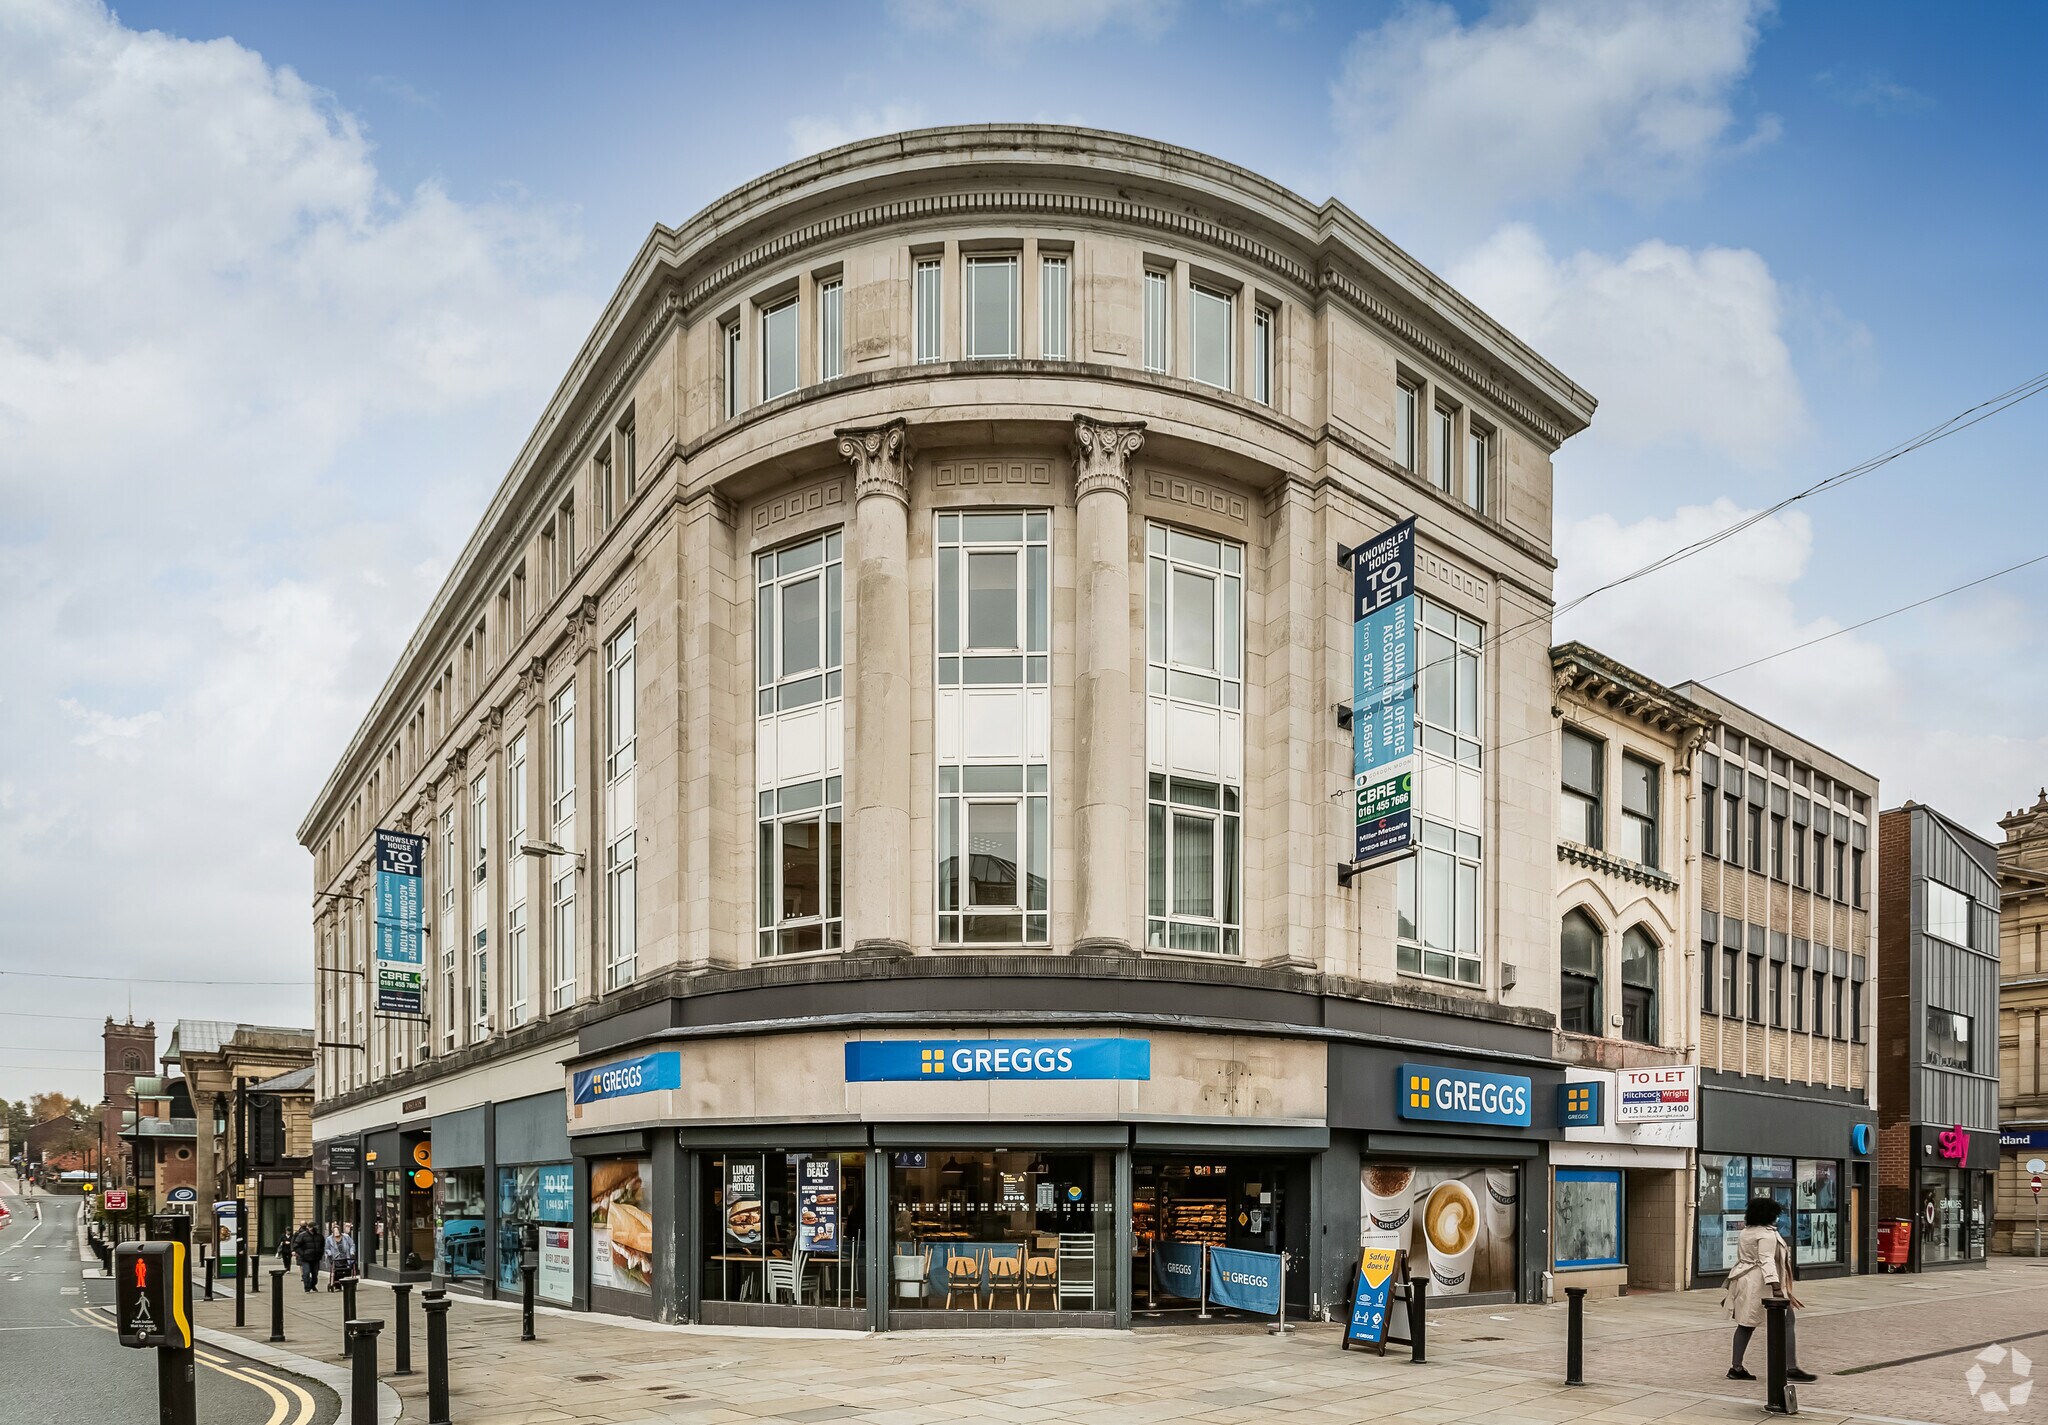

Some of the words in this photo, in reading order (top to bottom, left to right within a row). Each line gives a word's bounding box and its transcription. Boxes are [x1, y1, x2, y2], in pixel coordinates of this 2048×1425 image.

[1359, 527, 1411, 565] KNOWSLEY
[1368, 547, 1400, 571] HOUSE
[1366, 561, 1402, 591] TO
[1361, 575, 1408, 615] LET
[1394, 603, 1406, 640] HIGH
[1394, 642, 1406, 704] QUALITY
[1382, 624, 1394, 747] ACCOMMODATION
[1394, 705, 1406, 756] OFFICE
[1368, 767, 1392, 779] GORDON
[1357, 780, 1397, 806] CBRE
[1358, 803, 1375, 818] 0161
[1376, 799, 1390, 812] 455
[1391, 792, 1409, 807] 7666
[379, 833, 419, 847] KNOWSLEY
[1359, 831, 1377, 842] Miller
[1378, 821, 1408, 836] Metcalfe
[386, 849, 413, 863] TO
[387, 842, 412, 852] HOUSE
[382, 860, 418, 875] LET
[408, 878, 417, 898] HIGH
[400, 884, 408, 953] ACCOMMODATION
[408, 900, 417, 932] QUALITY
[408, 934, 417, 961] OFFICE
[379, 970, 411, 982] CBRE
[951, 1047, 1073, 1073] GREGGS
[602, 1065, 642, 1093] GREGGS
[1628, 1072, 1650, 1084] TO
[1655, 1071, 1686, 1083] LET
[1435, 1078, 1526, 1116] GREGGS
[1623, 1090, 1661, 1099] Hitchcock
[1662, 1089, 1688, 1099] Wright
[1622, 1106, 1643, 1114] 0151
[1647, 1105, 1664, 1113] 227
[1666, 1105, 1689, 1113] 3400
[732, 1164, 755, 1175] LUNCH
[806, 1167, 829, 1178] DEALS
[1726, 1166, 1735, 1177] TO
[1735, 1166, 1745, 1177] LET
[545, 1174, 555, 1193] TO
[557, 1174, 569, 1193] LET
[732, 1175, 743, 1183] JUST
[744, 1175, 755, 1183] GOT
[1378, 1211, 1409, 1229] GREGGS
[1366, 1261, 1382, 1270] does
[1383, 1263, 1390, 1271] it
[1369, 1252, 1390, 1263] Safely
[1167, 1262, 1192, 1275] GREGGS
[1231, 1272, 1268, 1288] GREGGS
[1434, 1271, 1464, 1285] GREGGS
